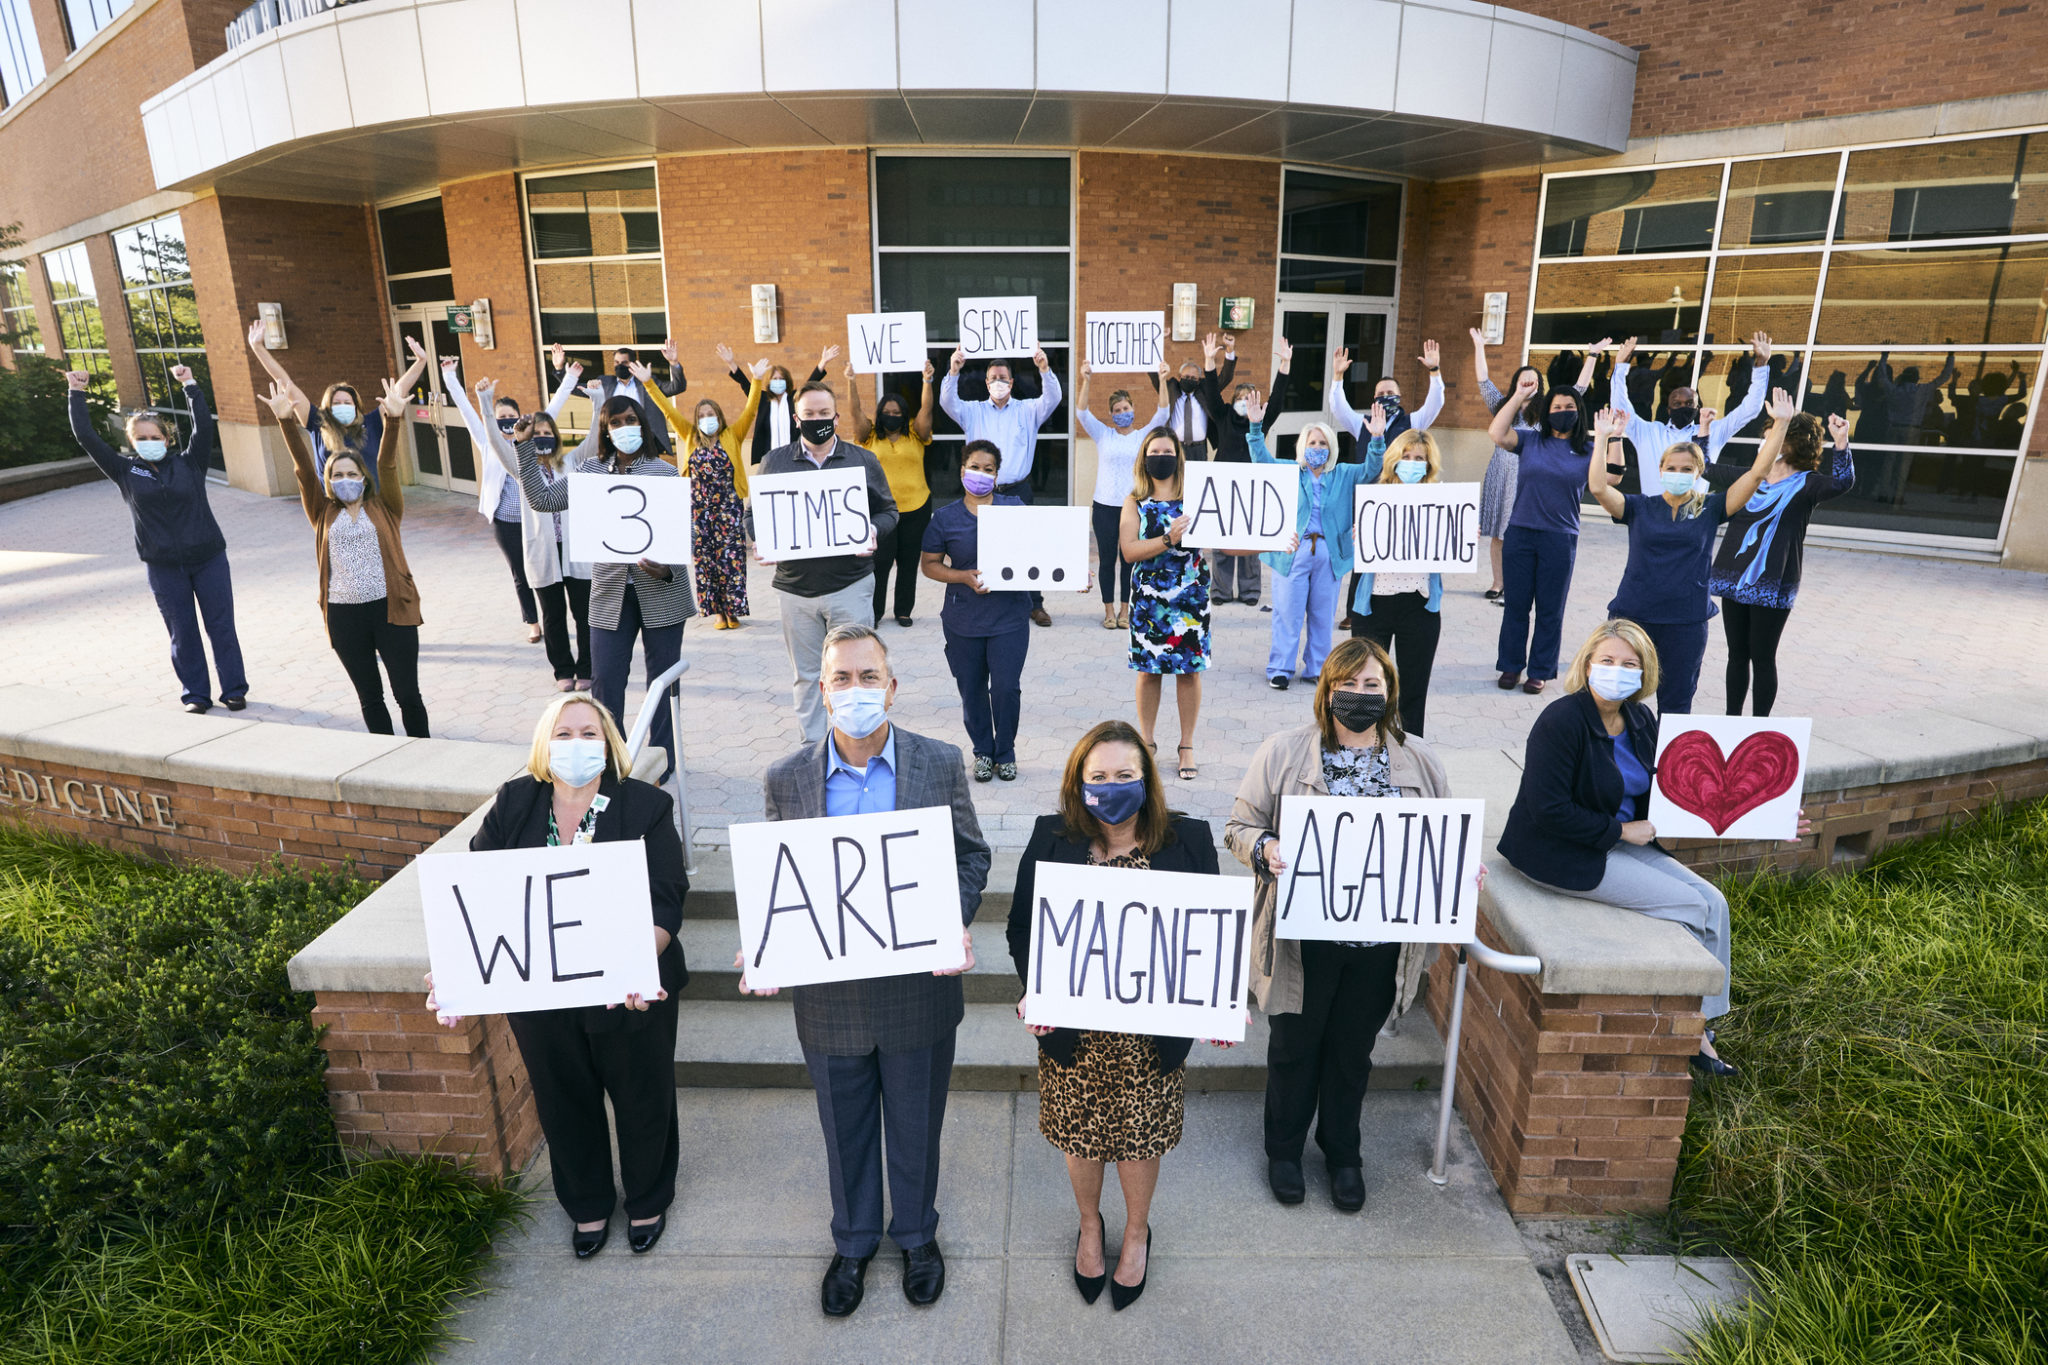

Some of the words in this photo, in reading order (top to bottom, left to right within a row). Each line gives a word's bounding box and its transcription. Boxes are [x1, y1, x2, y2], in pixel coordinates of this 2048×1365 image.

[862, 322, 906, 365] WE
[963, 308, 1032, 352] SERVE
[1087, 321, 1163, 366] TOGETHER
[602, 484, 654, 555] 3
[759, 485, 870, 550] TIMES
[1188, 476, 1285, 537] AND
[1358, 500, 1477, 565] COUNTING
[753, 829, 938, 969] ARE
[1282, 808, 1471, 926] AGAIN!
[452, 868, 605, 985] WE
[1035, 896, 1247, 1010] MAGNET!
